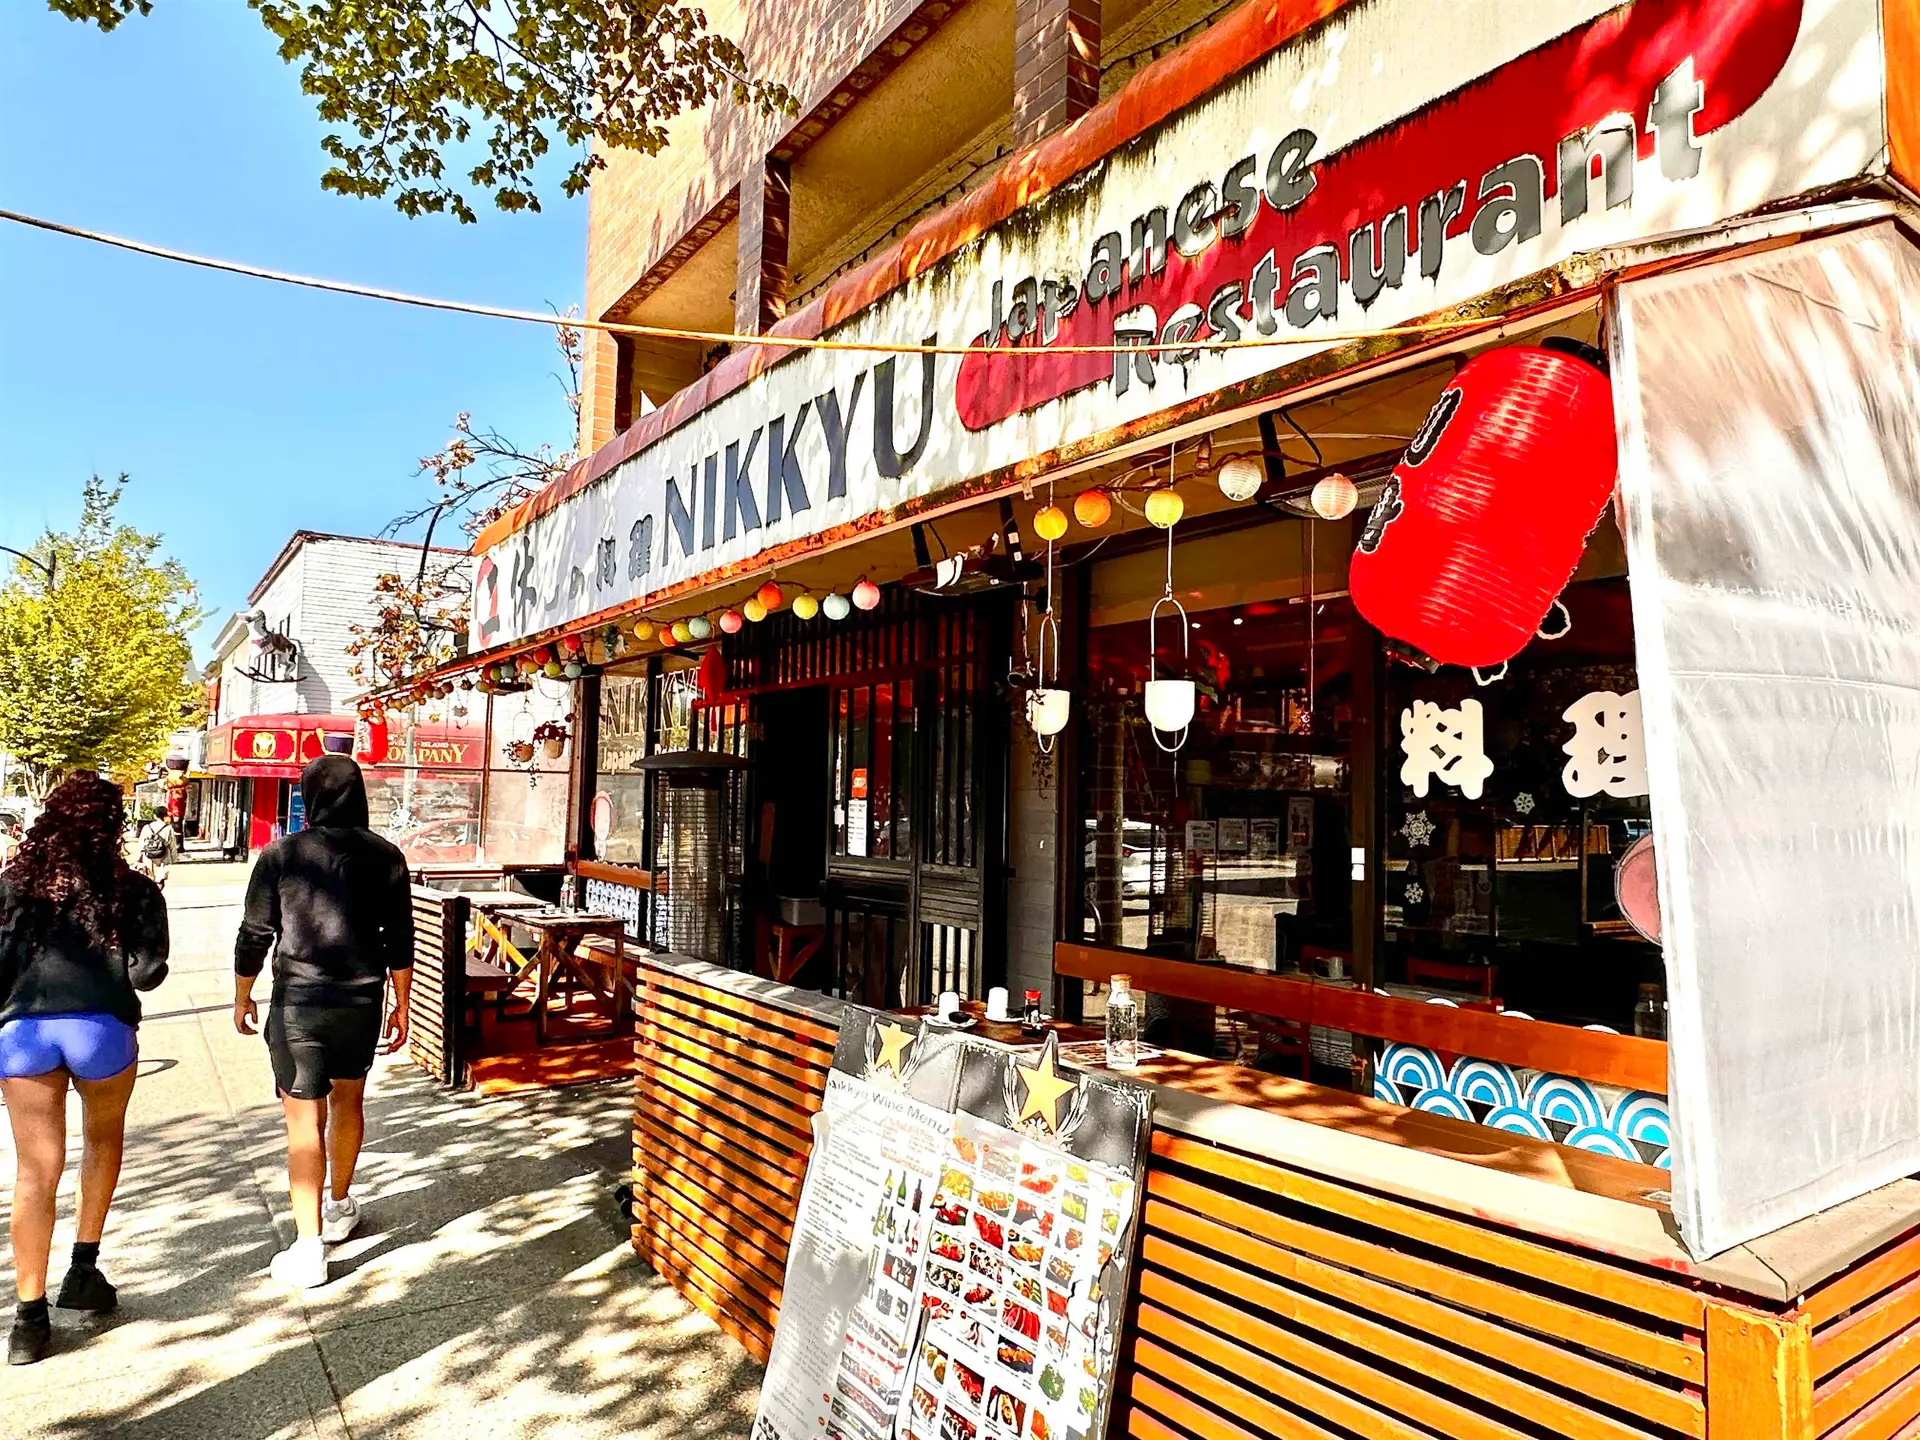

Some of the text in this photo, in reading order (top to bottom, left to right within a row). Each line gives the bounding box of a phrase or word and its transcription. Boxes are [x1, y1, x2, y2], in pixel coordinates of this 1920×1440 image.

[983, 128, 1318, 350] Japanese
[1113, 54, 1704, 397] Restaurant
[662, 331, 937, 567] NIKKYU
[386, 743, 469, 764] OPANY
[872, 1091, 904, 1113] Wine
[907, 1105, 950, 1135] Menu
